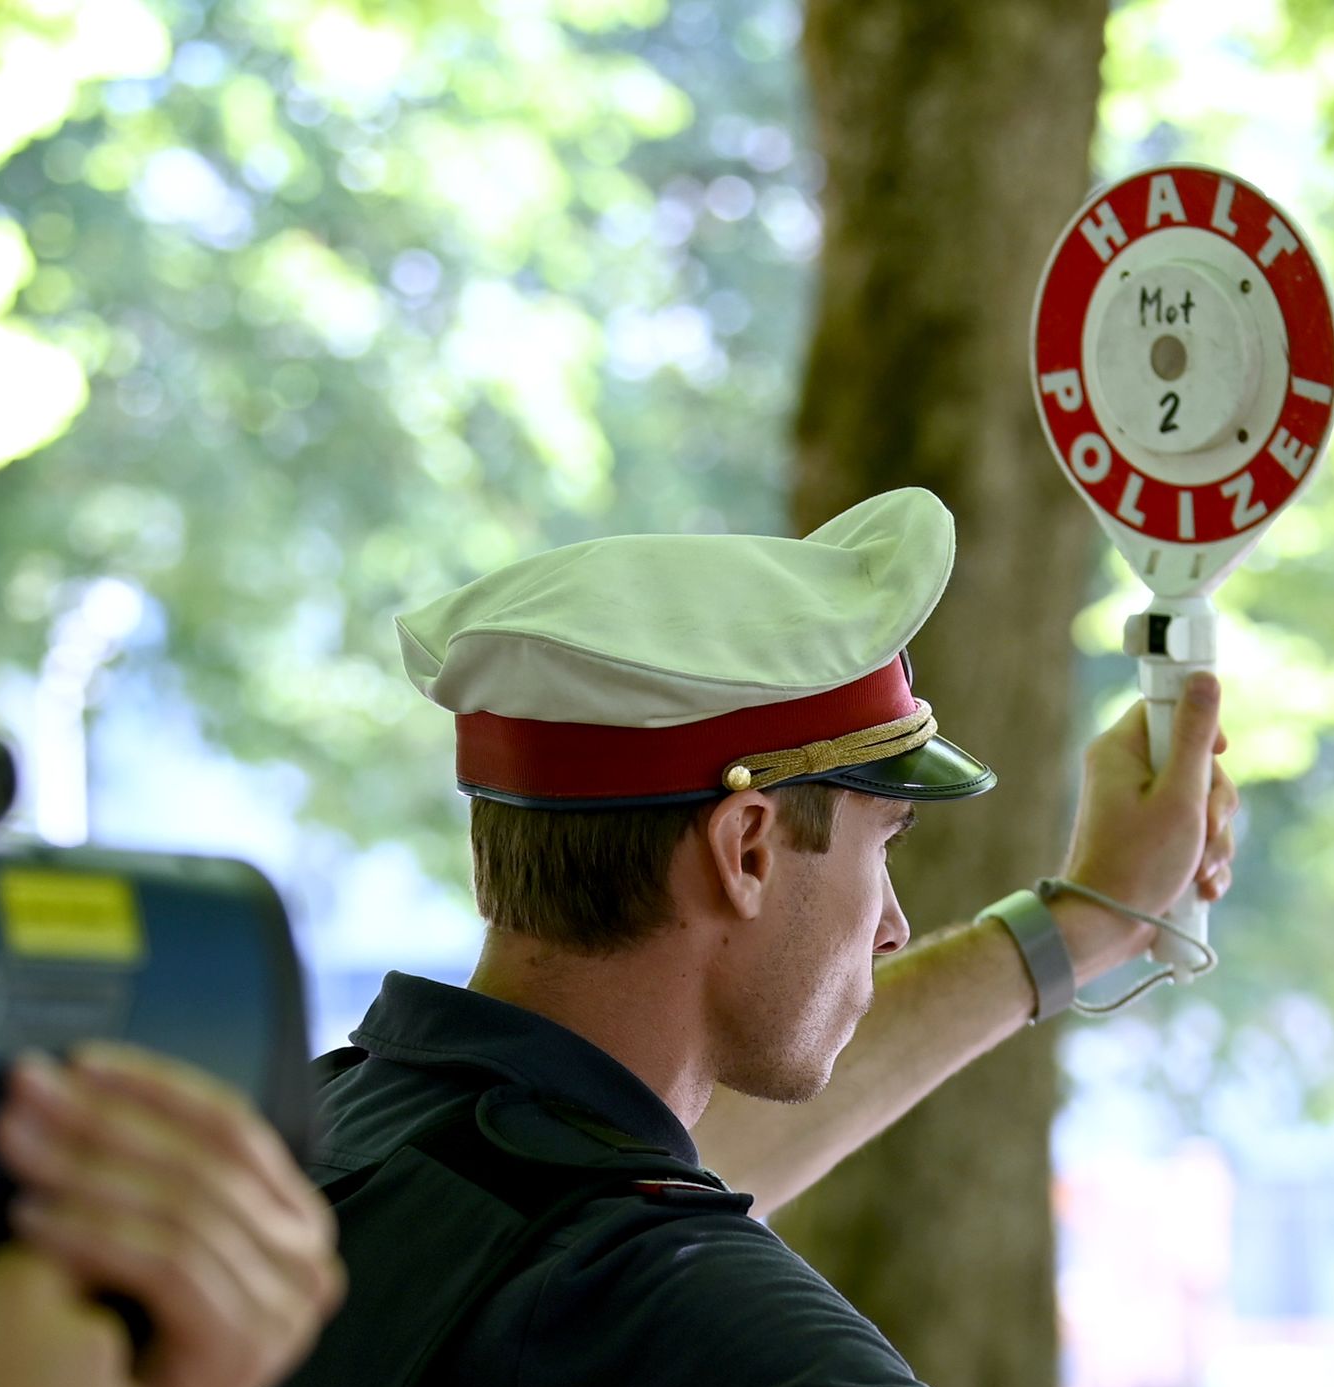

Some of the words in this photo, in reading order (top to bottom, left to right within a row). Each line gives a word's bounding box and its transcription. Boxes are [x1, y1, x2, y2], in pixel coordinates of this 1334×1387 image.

[1079, 174, 1300, 268] HALT
[1139, 287, 1196, 327] Mot
[1159, 391, 1181, 434] 2
[1040, 367, 1333, 541] POLIZEI
